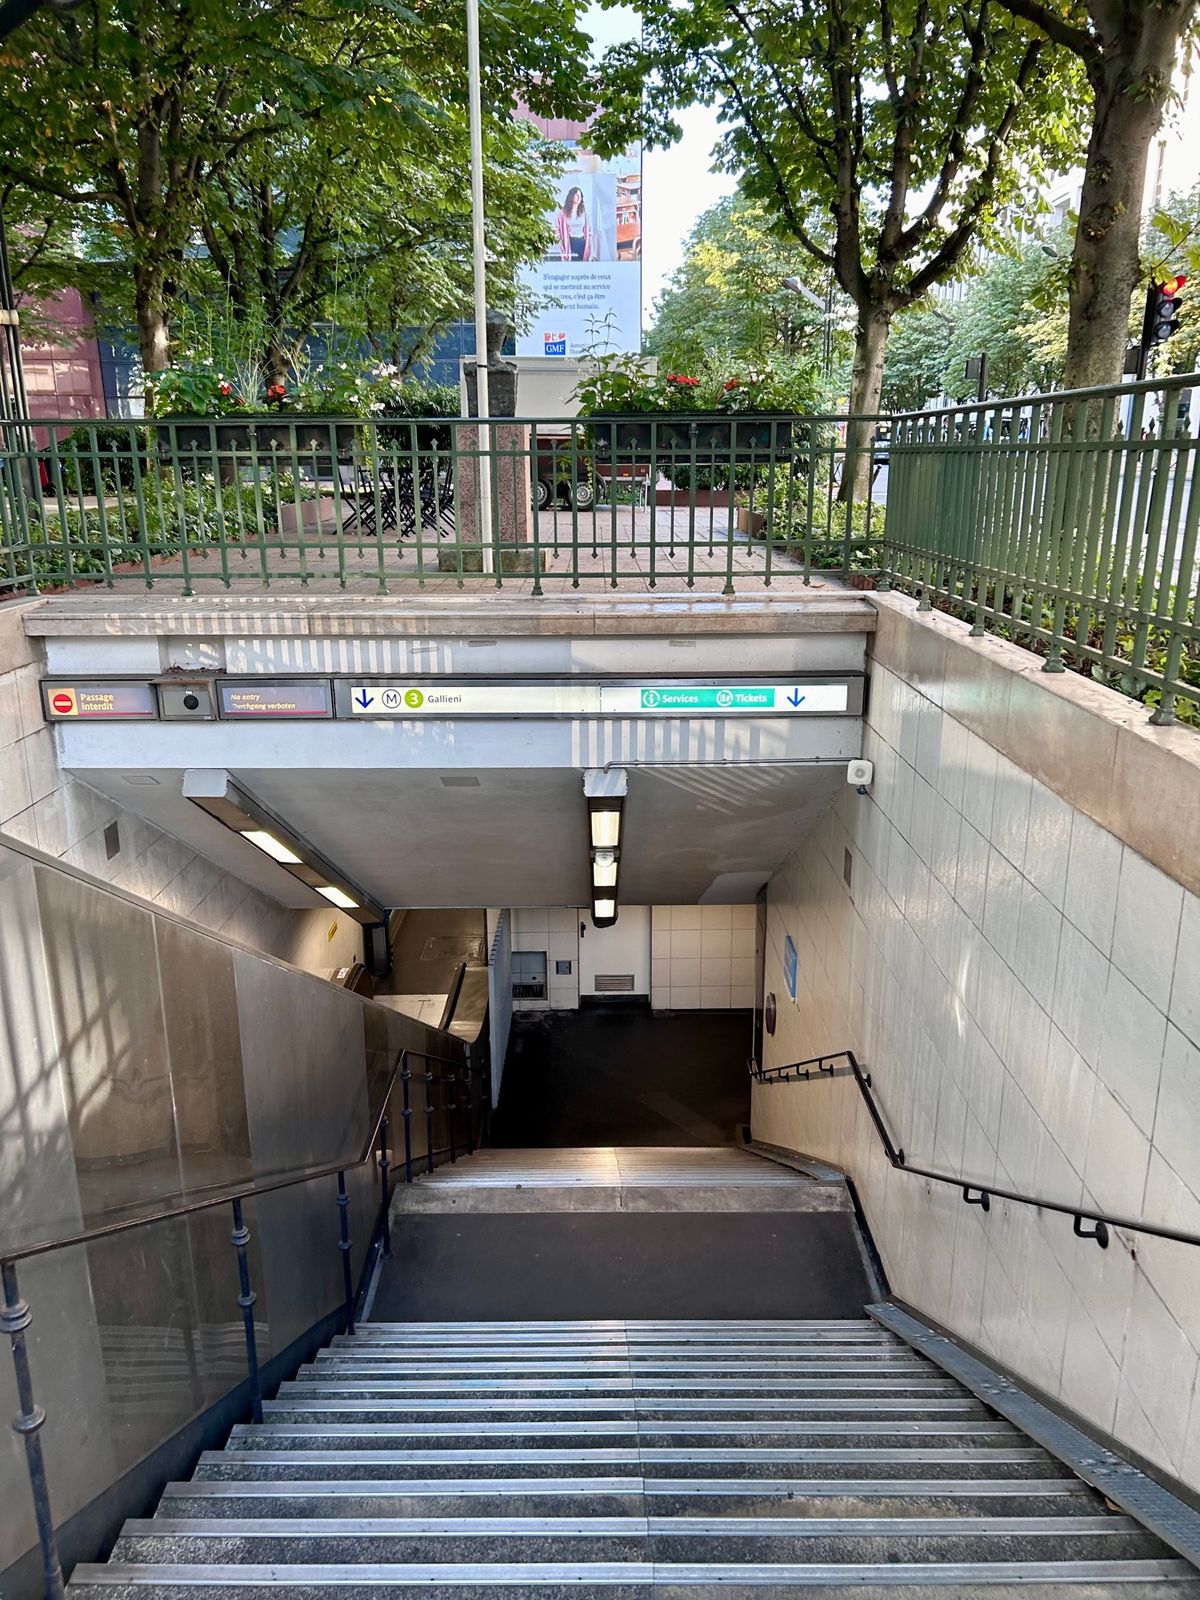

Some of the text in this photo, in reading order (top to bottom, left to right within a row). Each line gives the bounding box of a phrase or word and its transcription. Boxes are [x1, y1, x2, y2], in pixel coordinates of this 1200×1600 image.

[546, 344, 565, 353] GMF
[80, 693, 114, 702] Passage
[410, 693, 419, 705] 3
[427, 695, 462, 703] Gallieni
[662, 693, 768, 703] Services Tickets
[81, 702, 114, 710] interdit
